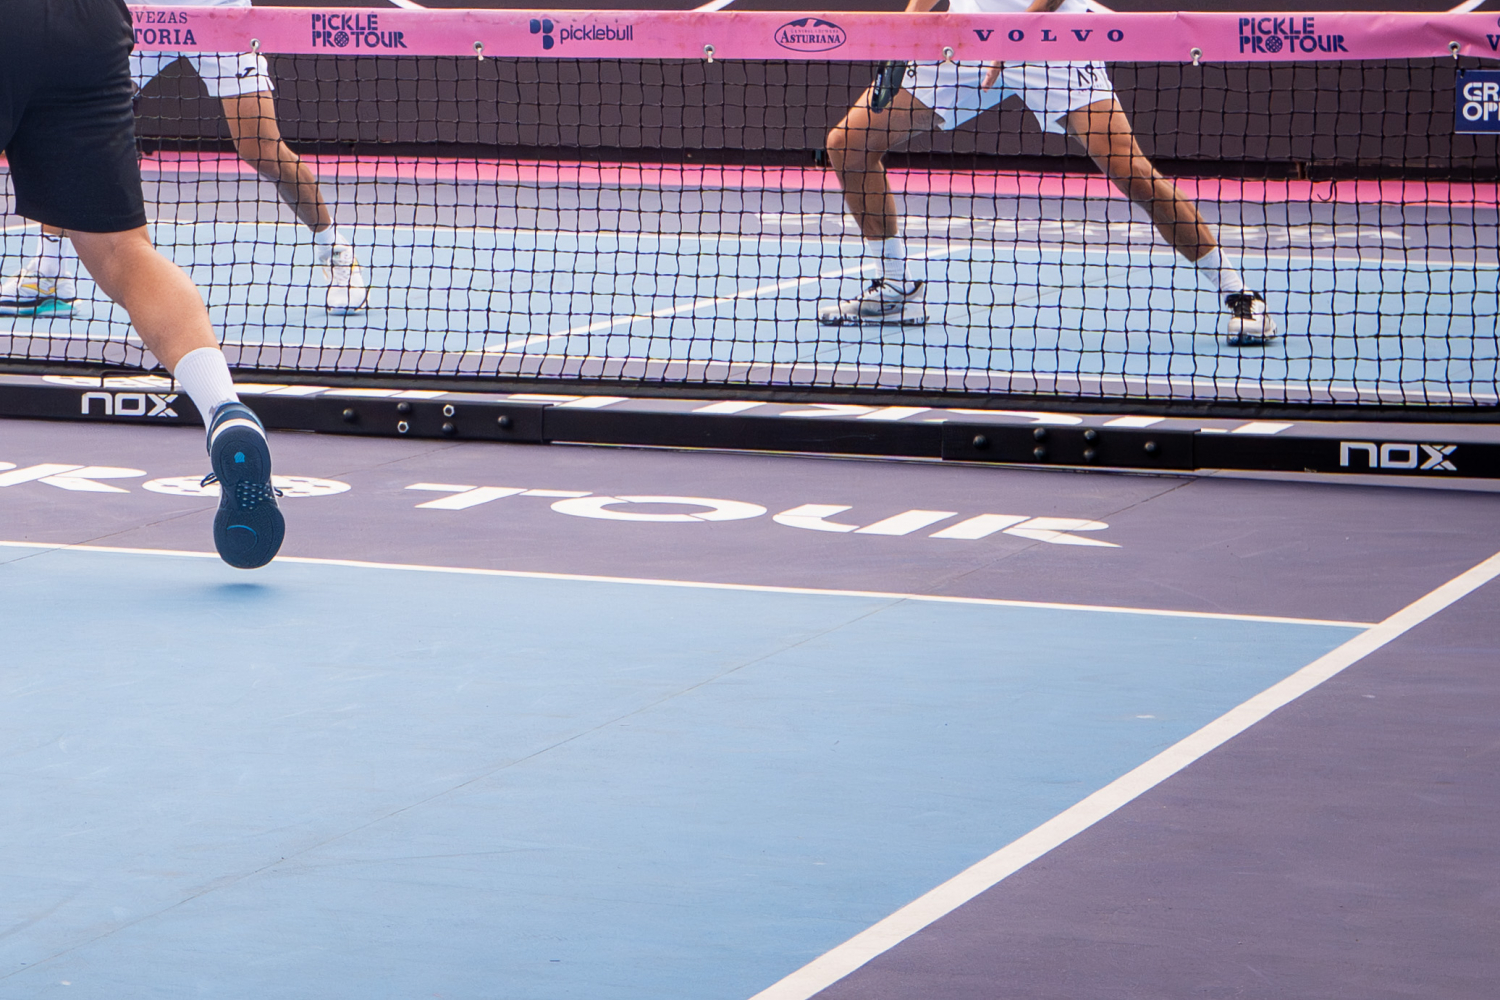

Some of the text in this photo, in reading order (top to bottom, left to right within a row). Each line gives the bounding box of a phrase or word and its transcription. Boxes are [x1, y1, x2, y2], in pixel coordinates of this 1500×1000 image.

[311, 13, 379, 31] PICKLE
[1238, 17, 1315, 35] PICKLE
[134, 28, 197, 46] TORIA
[560, 25, 634, 44] picklebull
[780, 30, 841, 44] ASTURIANA
[973, 28, 1125, 42] VOLVO
[1463, 82, 1500, 101] GR
[1463, 102, 1500, 121] OP
[404, 482, 1123, 548] TOUR
